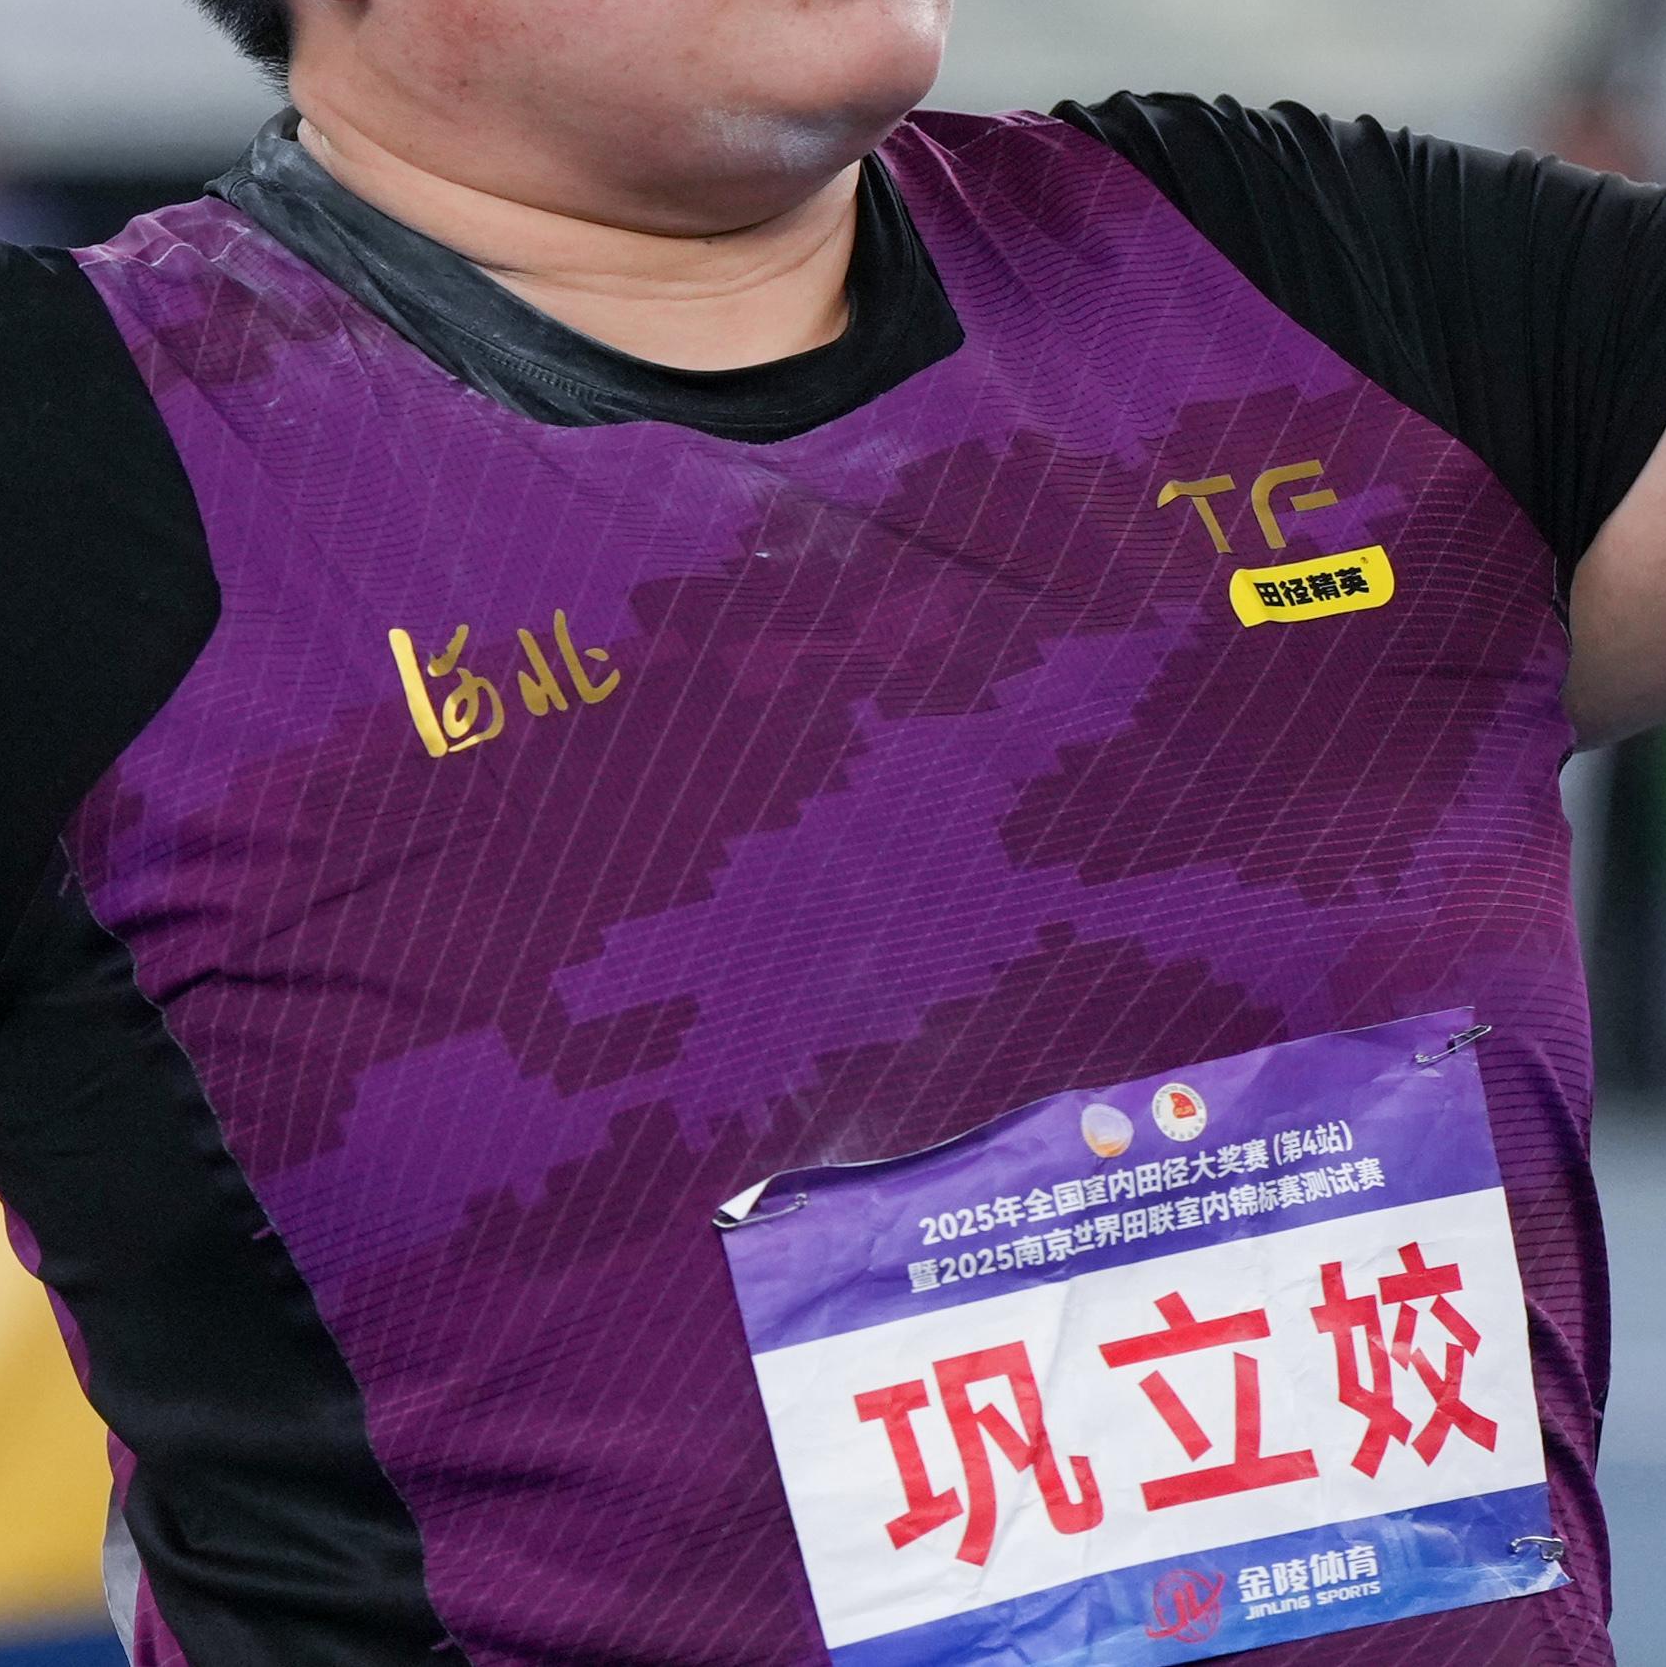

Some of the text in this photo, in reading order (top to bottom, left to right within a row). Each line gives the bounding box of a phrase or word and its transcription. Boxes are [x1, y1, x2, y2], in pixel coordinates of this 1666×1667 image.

[1156, 459, 1339, 554] TF
[1253, 566, 1370, 608] 田径精英
[907, 1157, 1386, 1294] 暨2025南京世界田联室内锦标赛测试赛
[853, 1240, 1499, 1569] 巩立姣
[1237, 1545, 1380, 1604] 金陵体育
[1244, 1580, 1381, 1621] JINLING SPORTS
